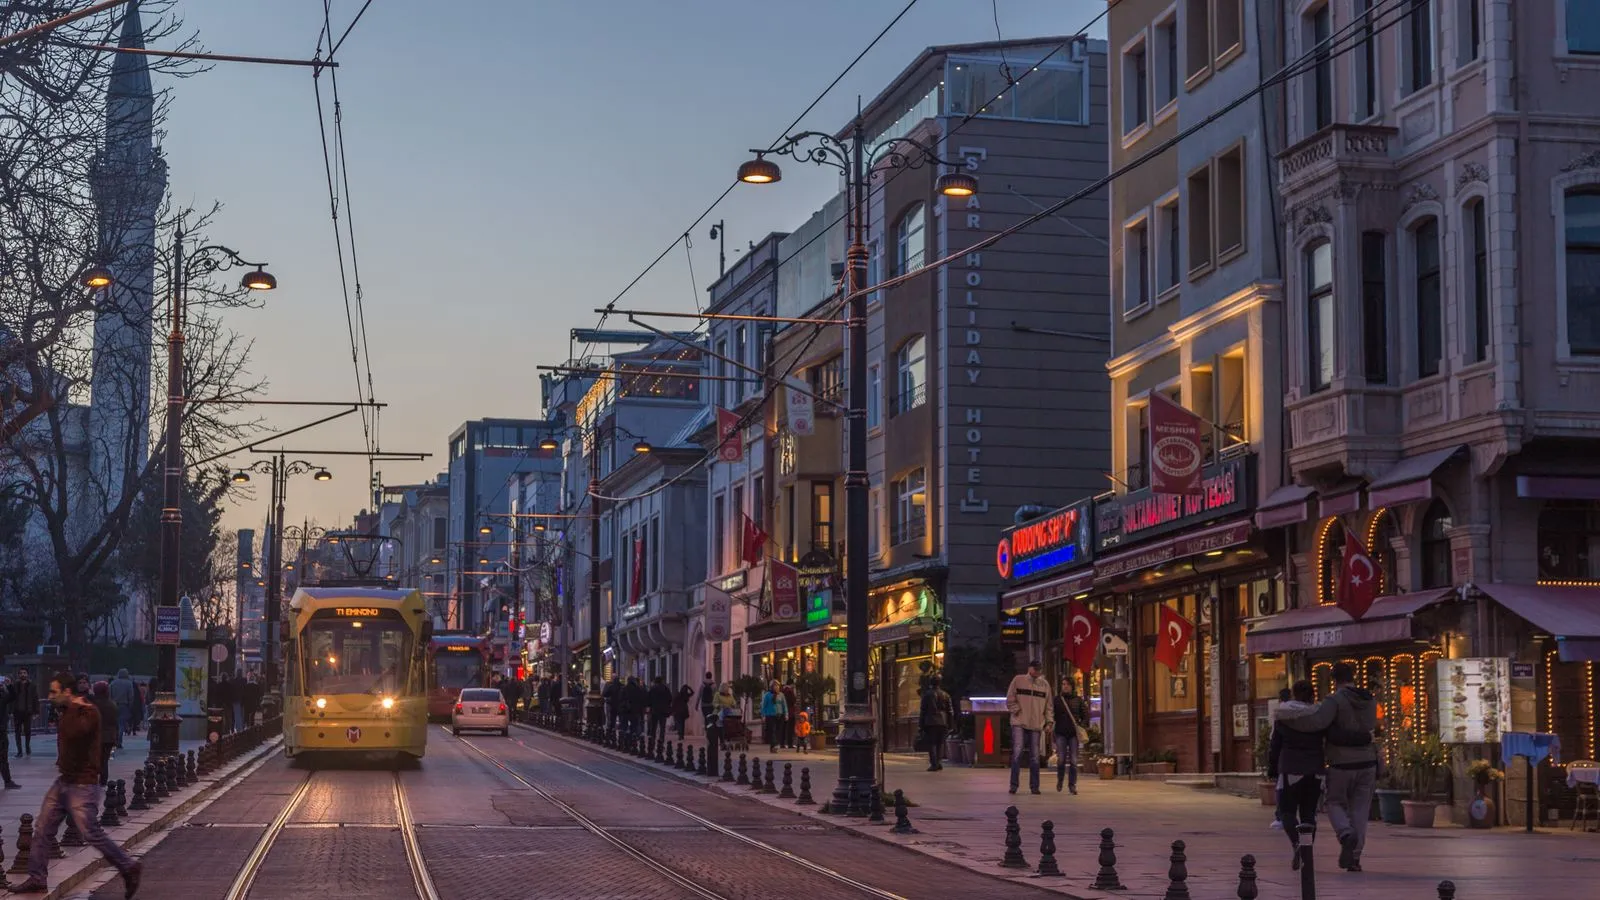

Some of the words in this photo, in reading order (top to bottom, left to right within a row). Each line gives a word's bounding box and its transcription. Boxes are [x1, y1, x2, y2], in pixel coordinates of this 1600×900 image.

[966, 157, 980, 229] SAR
[966, 253, 980, 384] HOLIDAY
[966, 409, 981, 503] HOTEL
[1012, 521, 1047, 557] PUDDING
[336, 608, 344, 616] T1
